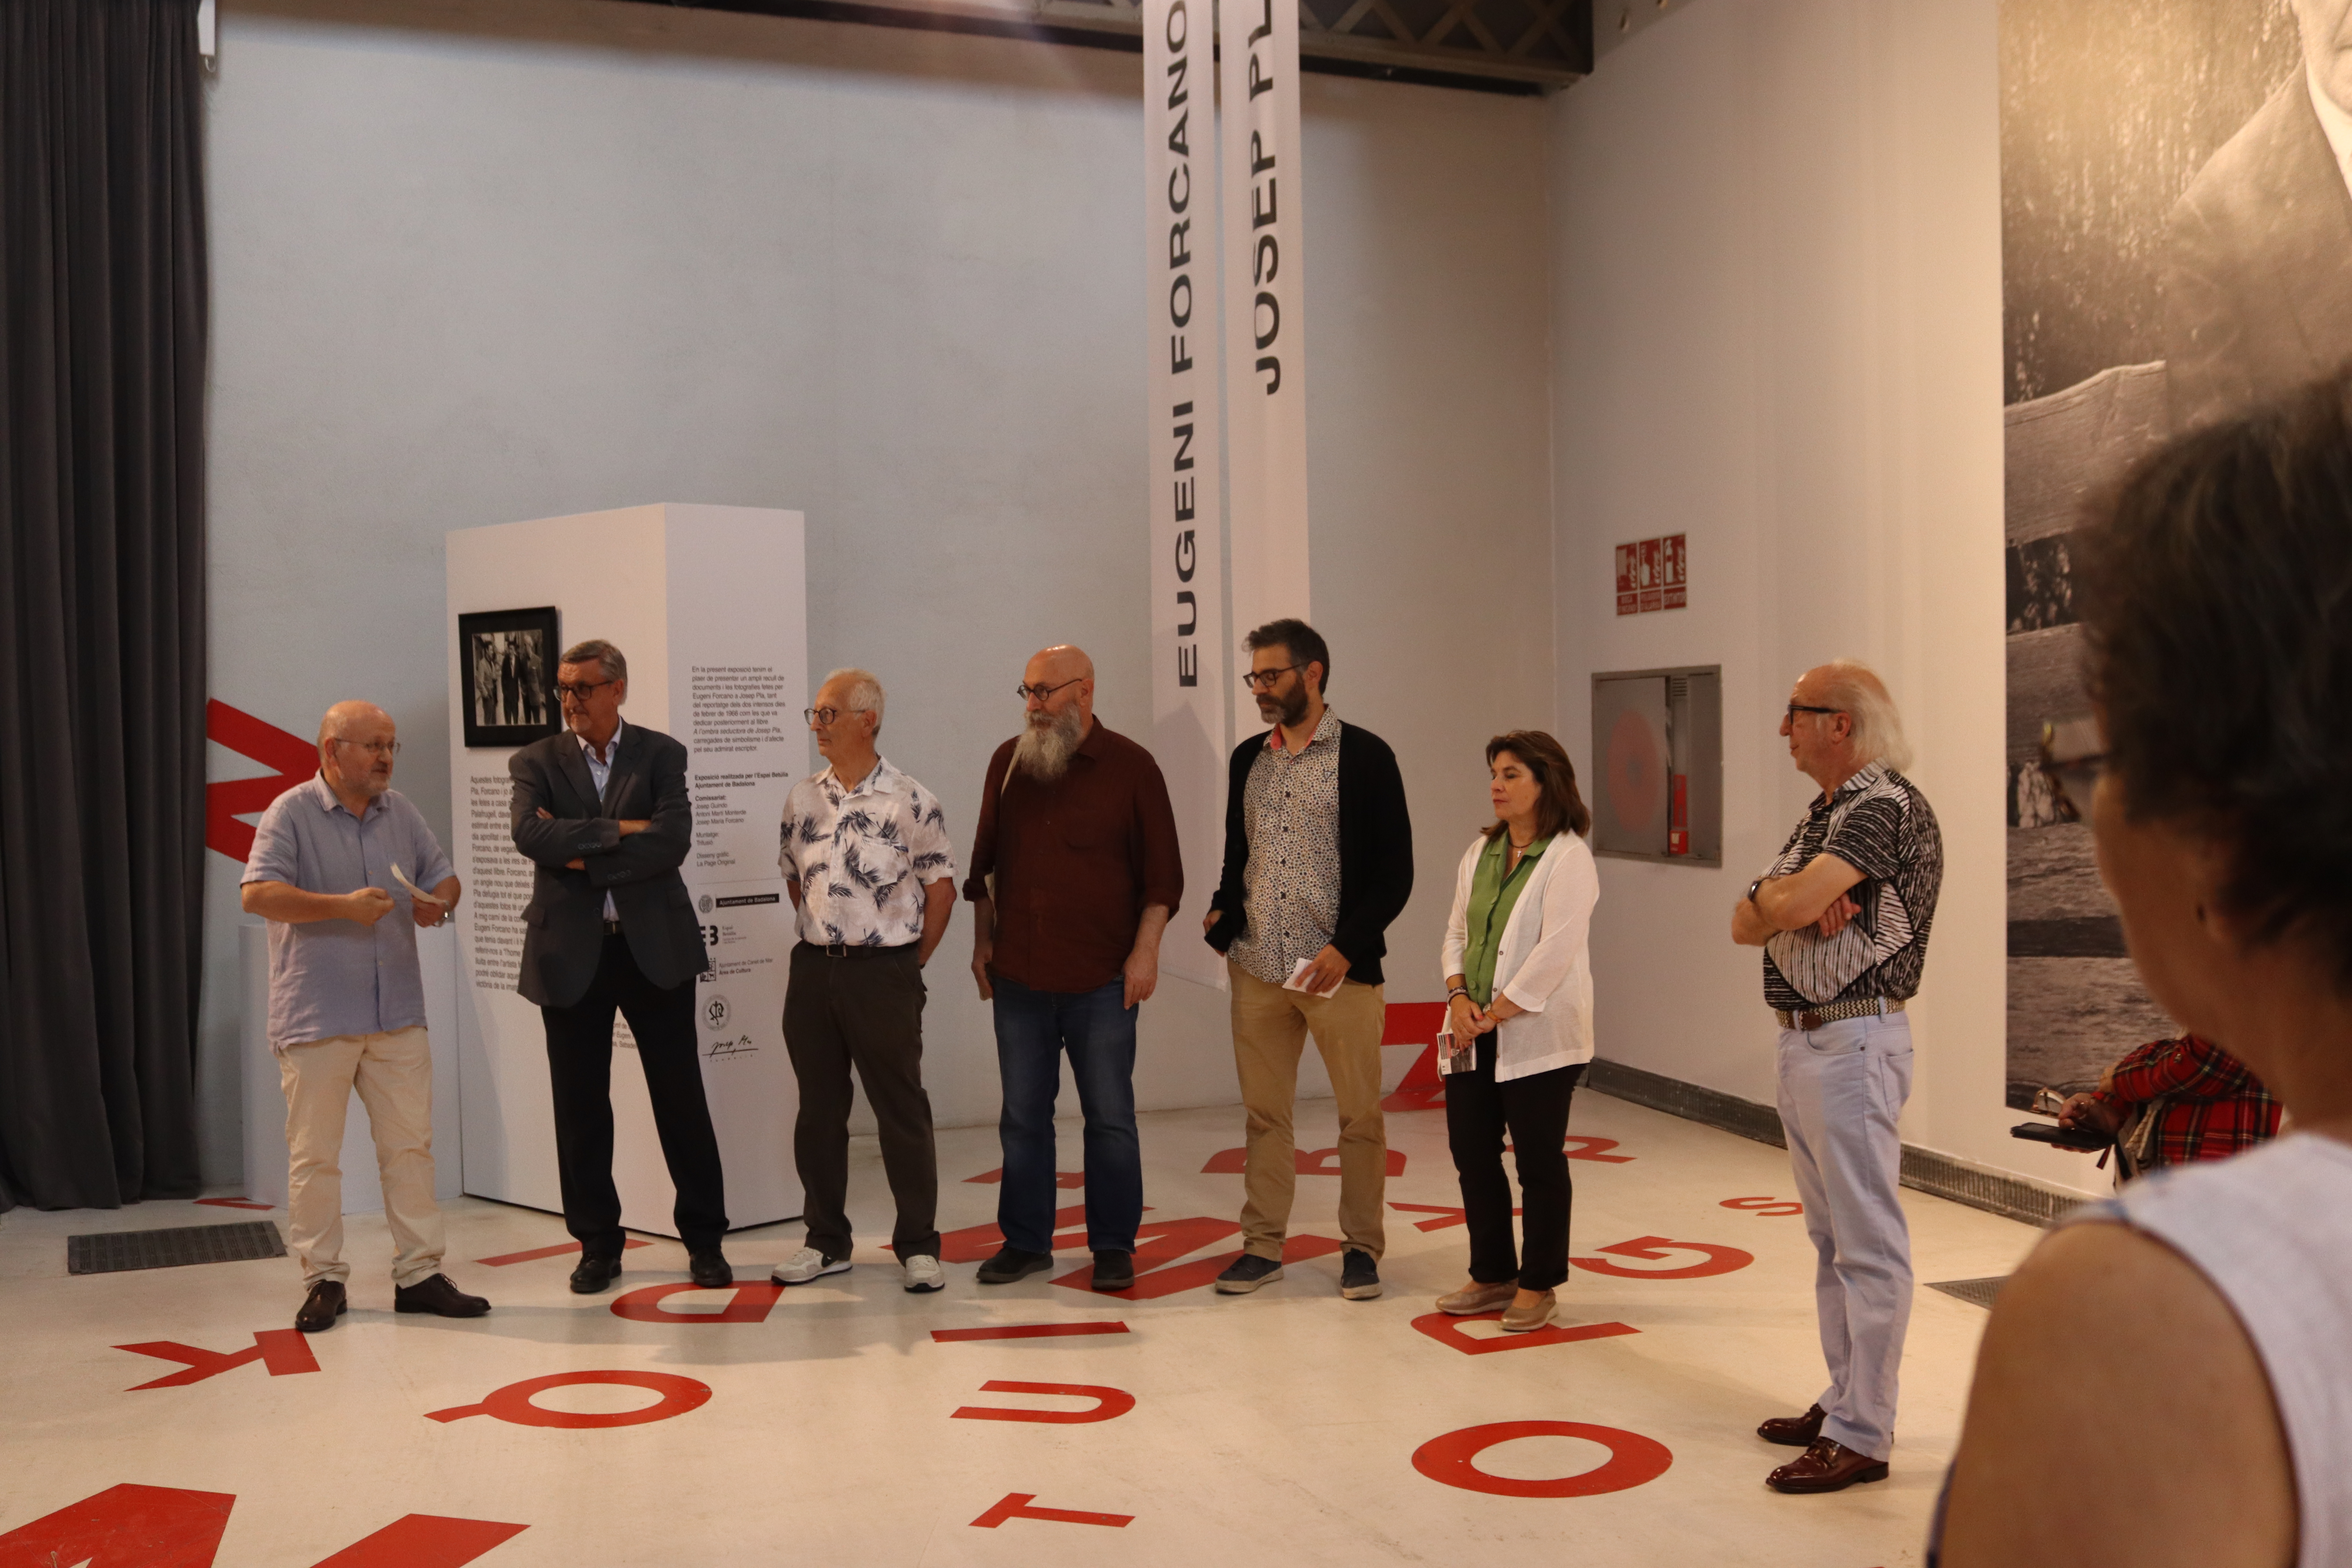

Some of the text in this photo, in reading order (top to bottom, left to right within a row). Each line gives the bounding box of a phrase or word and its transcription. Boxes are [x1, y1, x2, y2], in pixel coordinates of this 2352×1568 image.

[1248, 0, 1281, 395] JOSEP PL
[1167, 0, 1197, 687] EUGENI FORCANO
[109, 1328, 321, 1392] K
[423, 1370, 712, 1429] Q
[949, 1380, 1136, 1424] U
[1411, 1420, 1673, 1498] O
[968, 1492, 1136, 1528] T
